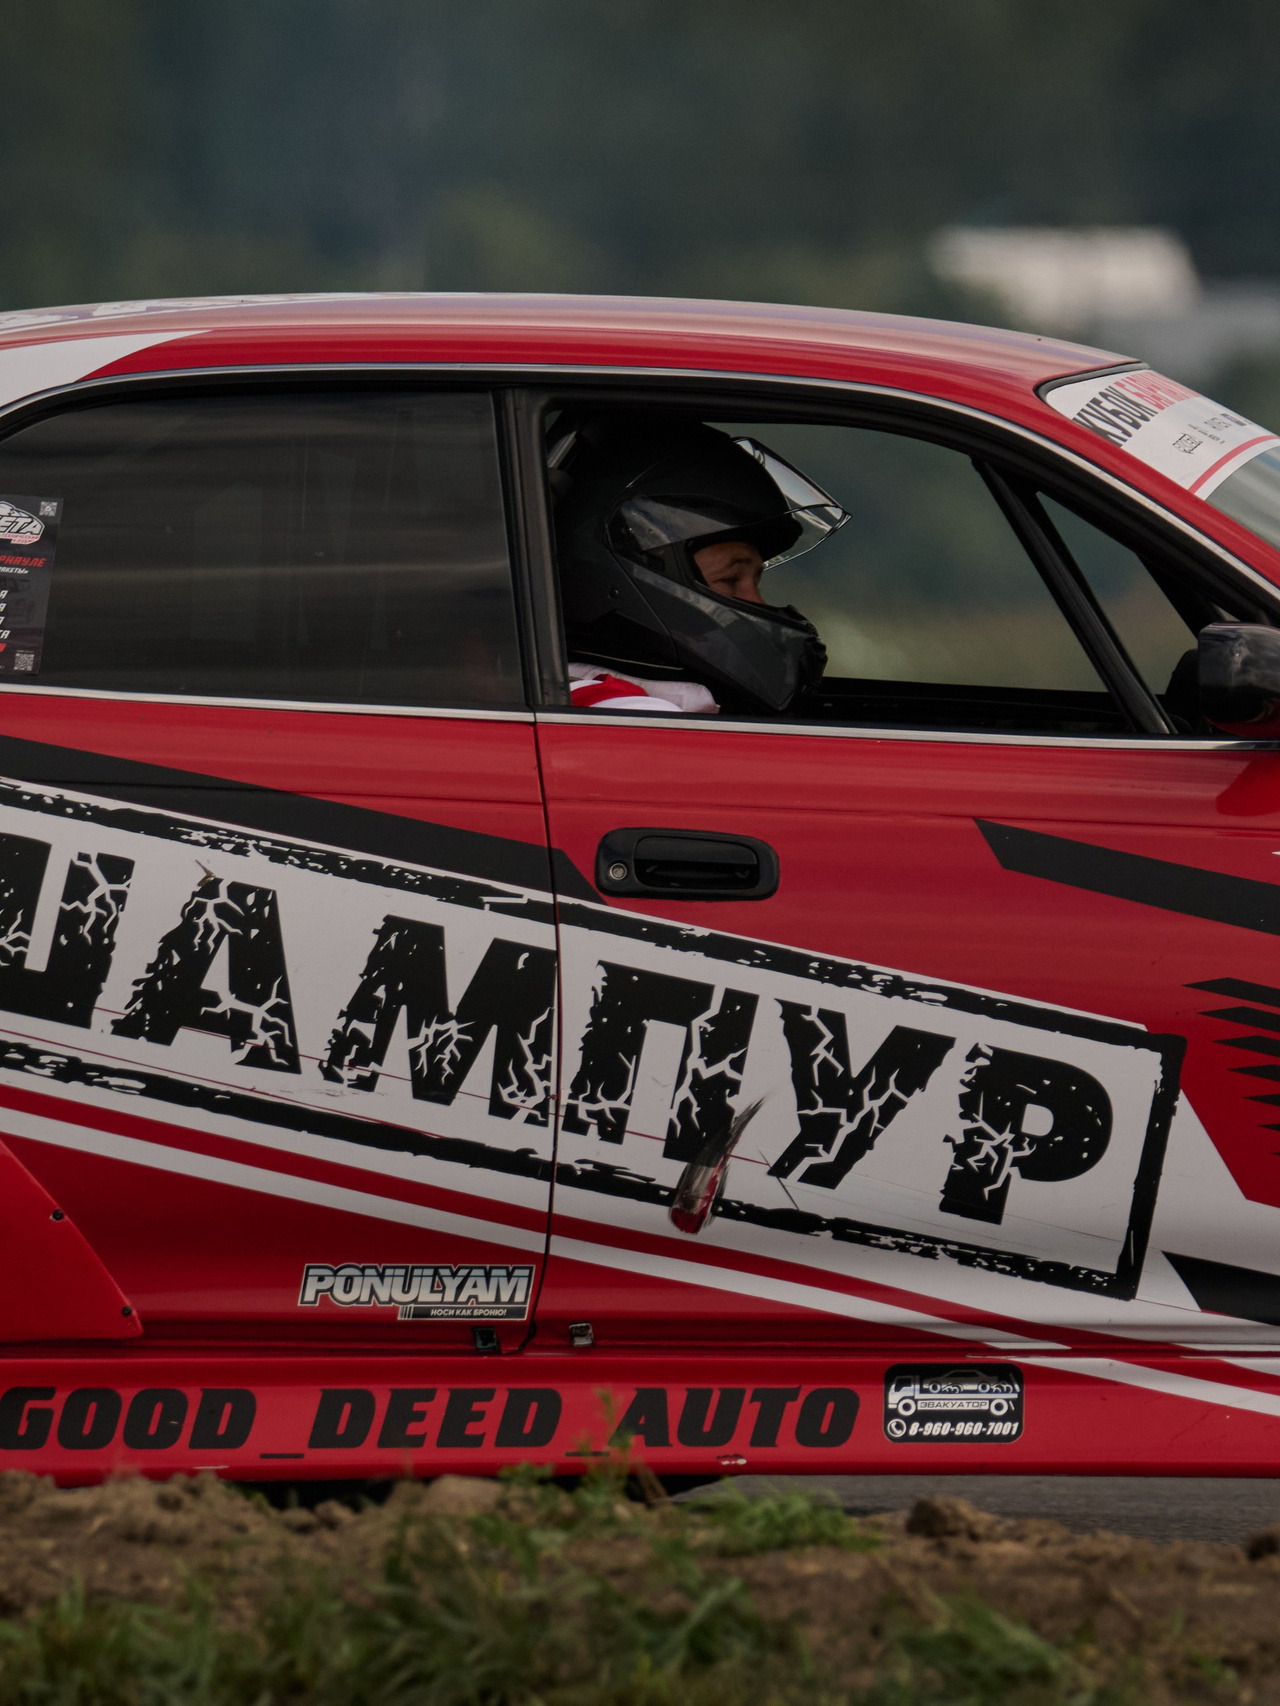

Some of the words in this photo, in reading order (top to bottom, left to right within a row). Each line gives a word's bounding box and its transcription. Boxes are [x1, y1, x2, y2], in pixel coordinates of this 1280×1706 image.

[1072, 385, 1159, 448] КУБОК
[0, 515, 42, 534] ЕТА
[300, 1265, 534, 1305] PONULYAM
[430, 1308, 454, 1316] НОСИ
[455, 1308, 472, 1316] КАК
[473, 1308, 507, 1316] БРОНЮ!
[919, 1401, 988, 1409] ЭВАКУАТОР
[908, 1421, 1019, 1436] 8-960-960-7001
